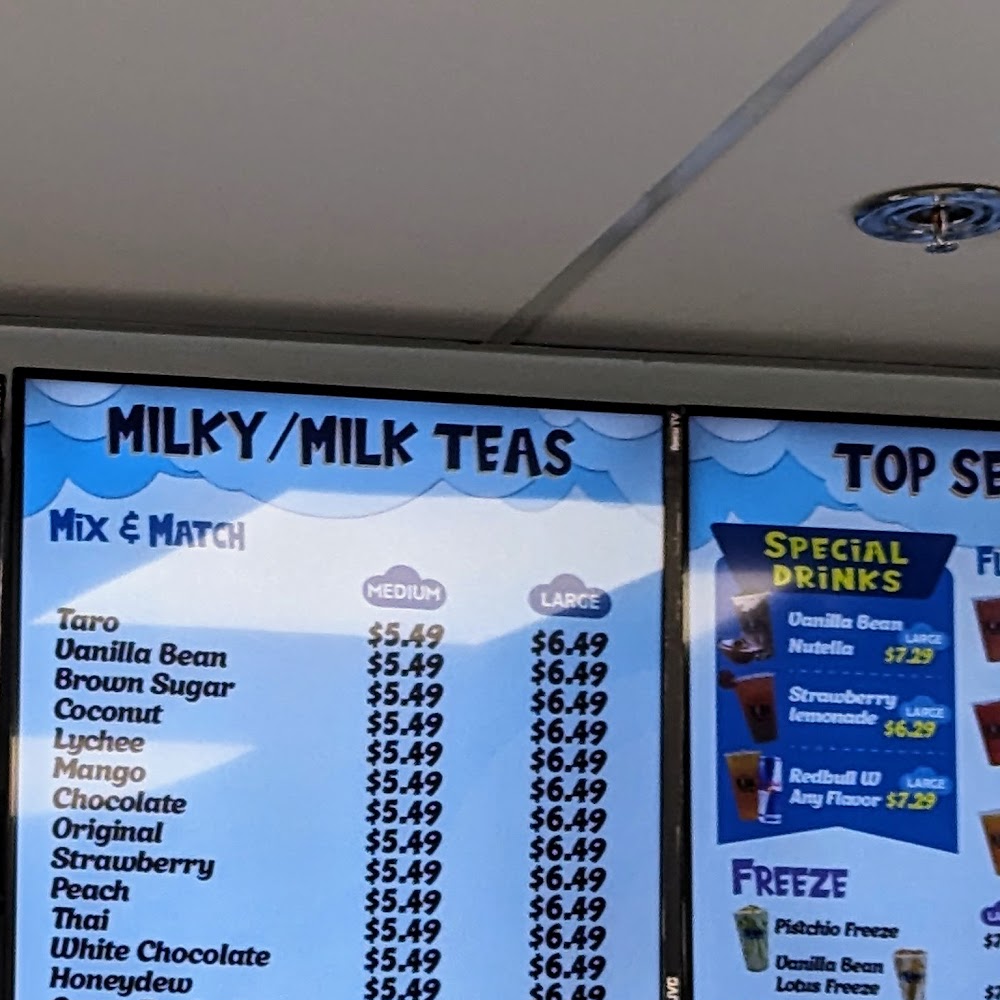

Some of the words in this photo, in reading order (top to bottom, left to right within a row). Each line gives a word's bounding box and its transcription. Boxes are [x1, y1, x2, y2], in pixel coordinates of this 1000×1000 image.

[120, 511, 140, 544] &
[57, 607, 120, 632] Taro
[788, 612, 852, 630] Vanilla
[857, 615, 904, 631] Bean
[368, 622, 445, 648] $5.49
[530, 629, 609, 656] $6.49
[787, 638, 855, 656] Nutella
[55, 638, 152, 664] Vanilla
[159, 644, 227, 667] Bean
[55, 668, 144, 693] Brown
[150, 673, 235, 701] Sugar
[54, 698, 163, 724] Coconut
[789, 687, 898, 709] Strawberry
[54, 728, 145, 755] Lychee
[883, 721, 937, 738] $6.29
[52, 757, 146, 786] Mango
[789, 769, 857, 786] Redbull
[52, 787, 187, 814] Chocolate
[789, 790, 823, 809] Any
[826, 791, 883, 808] Flavor
[52, 817, 164, 846] Original
[50, 847, 214, 880] Strawberry
[50, 877, 130, 901] Peach
[52, 906, 110, 930] Thai
[845, 923, 899, 938] Freeze
[50, 936, 130, 961] White
[137, 940, 271, 966] Chocolate
[50, 967, 193, 996] Honeydew
